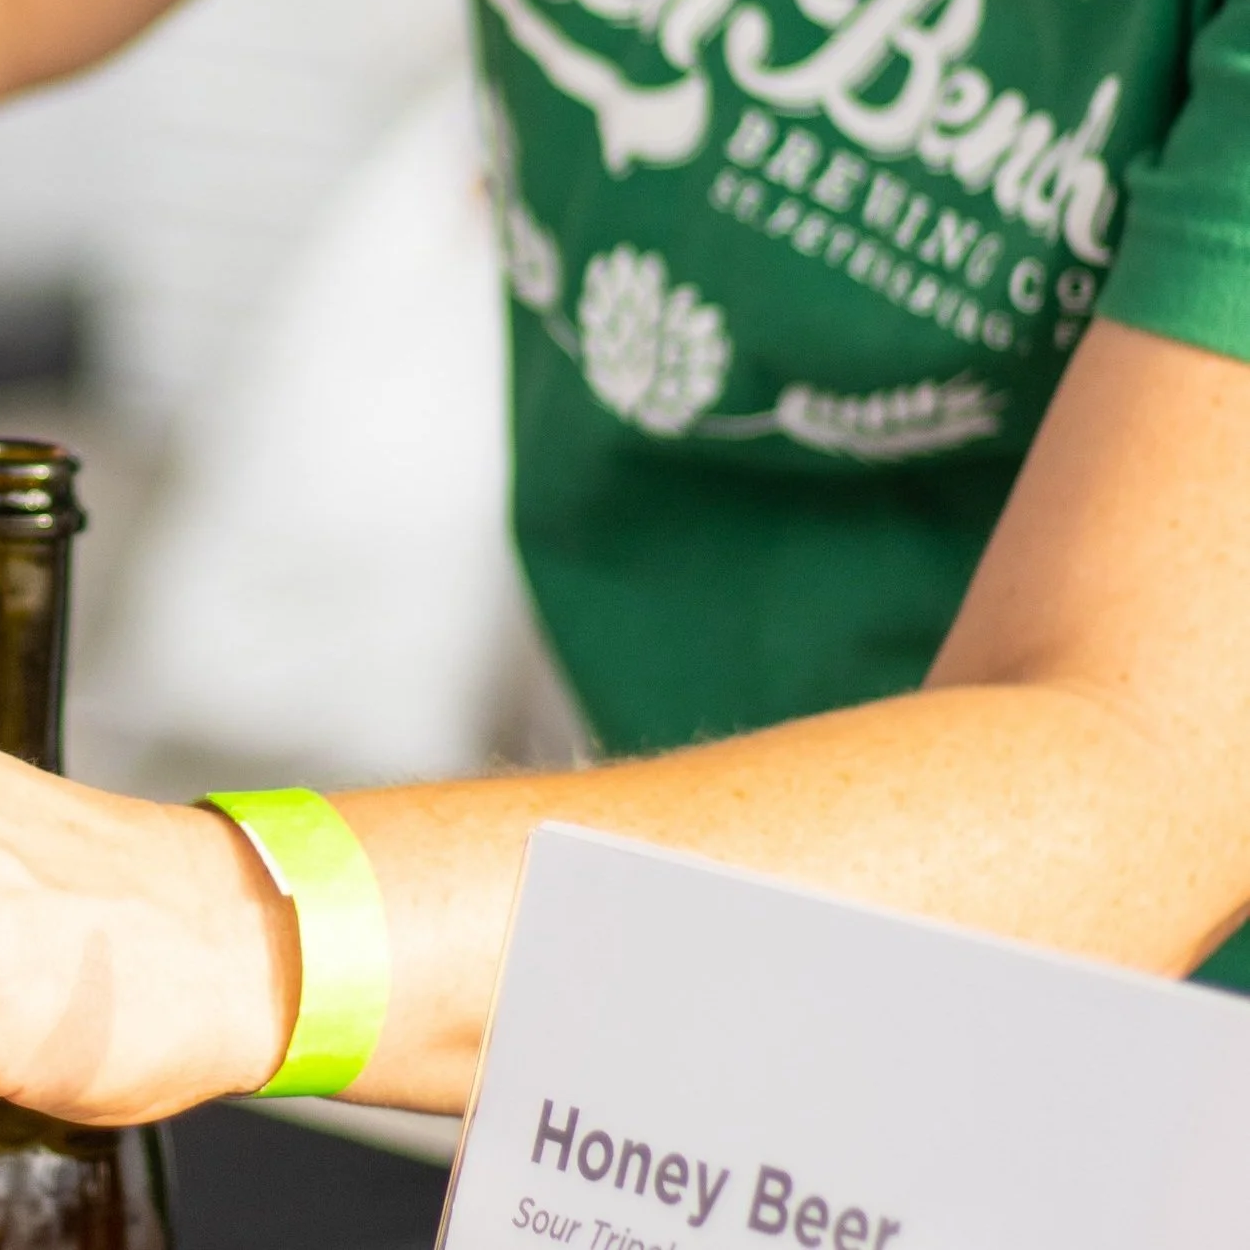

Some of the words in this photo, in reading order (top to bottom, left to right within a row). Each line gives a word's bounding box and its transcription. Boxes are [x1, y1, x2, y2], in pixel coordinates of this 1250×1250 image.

[726, 108, 1006, 290] BREWING
[511, 1196, 583, 1244] Sour
[530, 1098, 731, 1228] Honey
[747, 1163, 902, 1250] Beer
